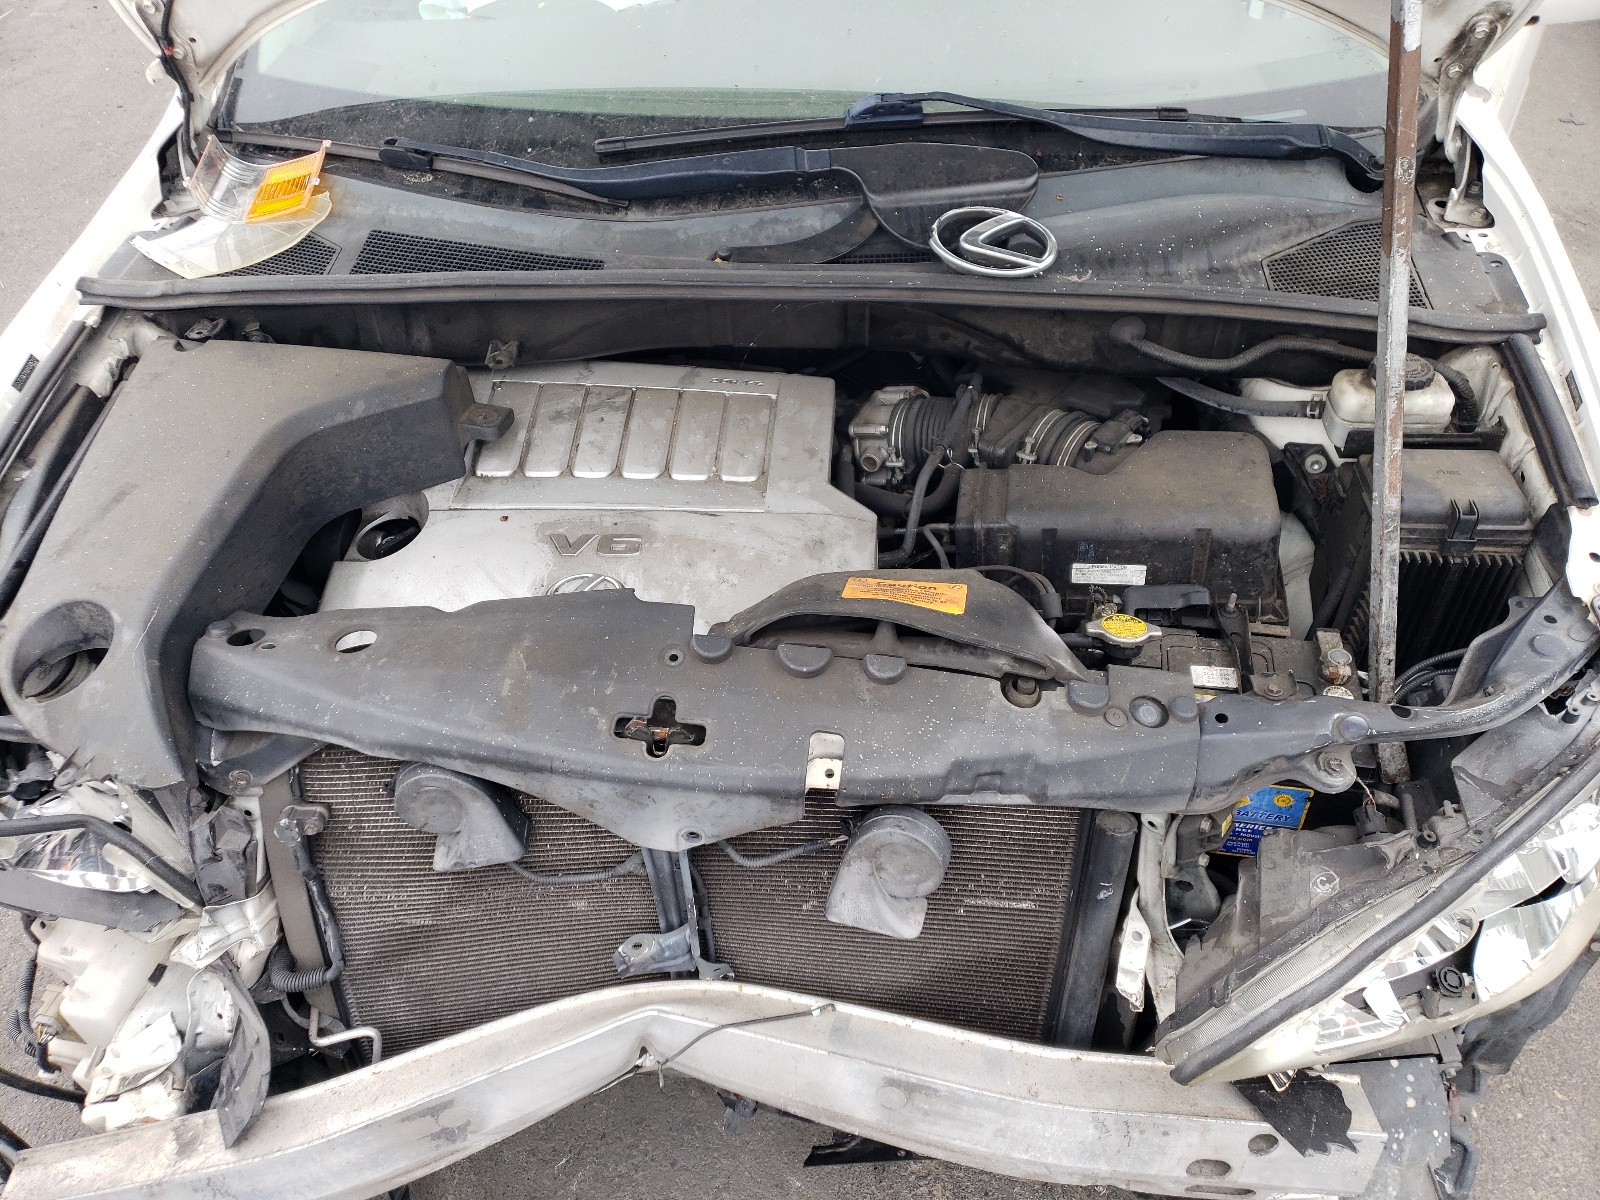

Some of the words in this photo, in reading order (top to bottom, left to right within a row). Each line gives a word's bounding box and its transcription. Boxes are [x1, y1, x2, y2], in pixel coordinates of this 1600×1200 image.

[549, 533, 642, 557] V6
[877, 581, 937, 591] Caution
[1236, 809, 1292, 822] BATTERY
